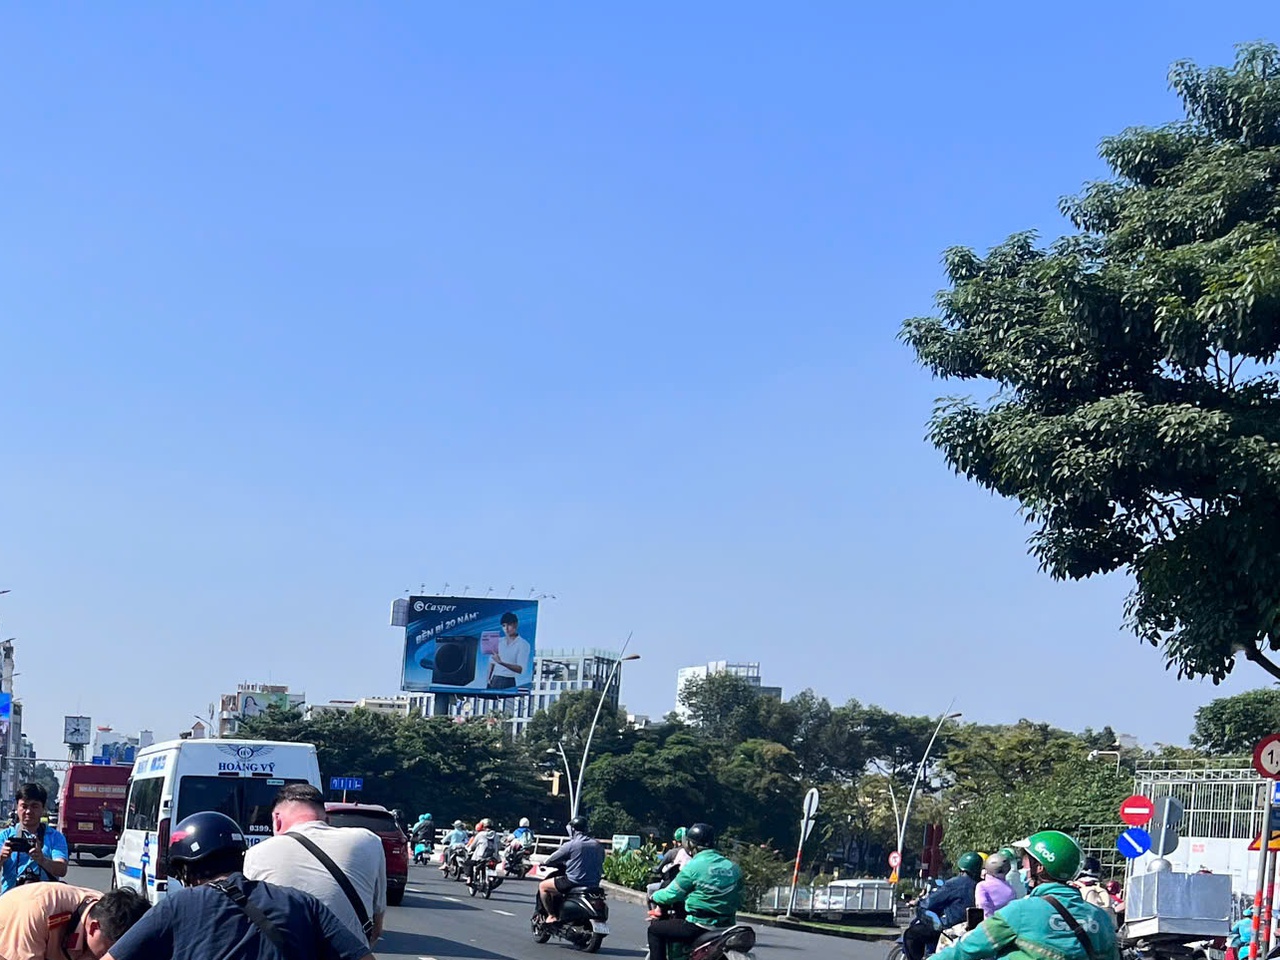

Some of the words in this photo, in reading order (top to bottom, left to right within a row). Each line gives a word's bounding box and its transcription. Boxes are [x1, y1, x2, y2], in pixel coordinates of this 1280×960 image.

[424, 602, 457, 613] Casper
[445, 619, 456, 630] 20
[218, 761, 258, 772] HOÀNG
[1034, 842, 1055, 863] Grab
